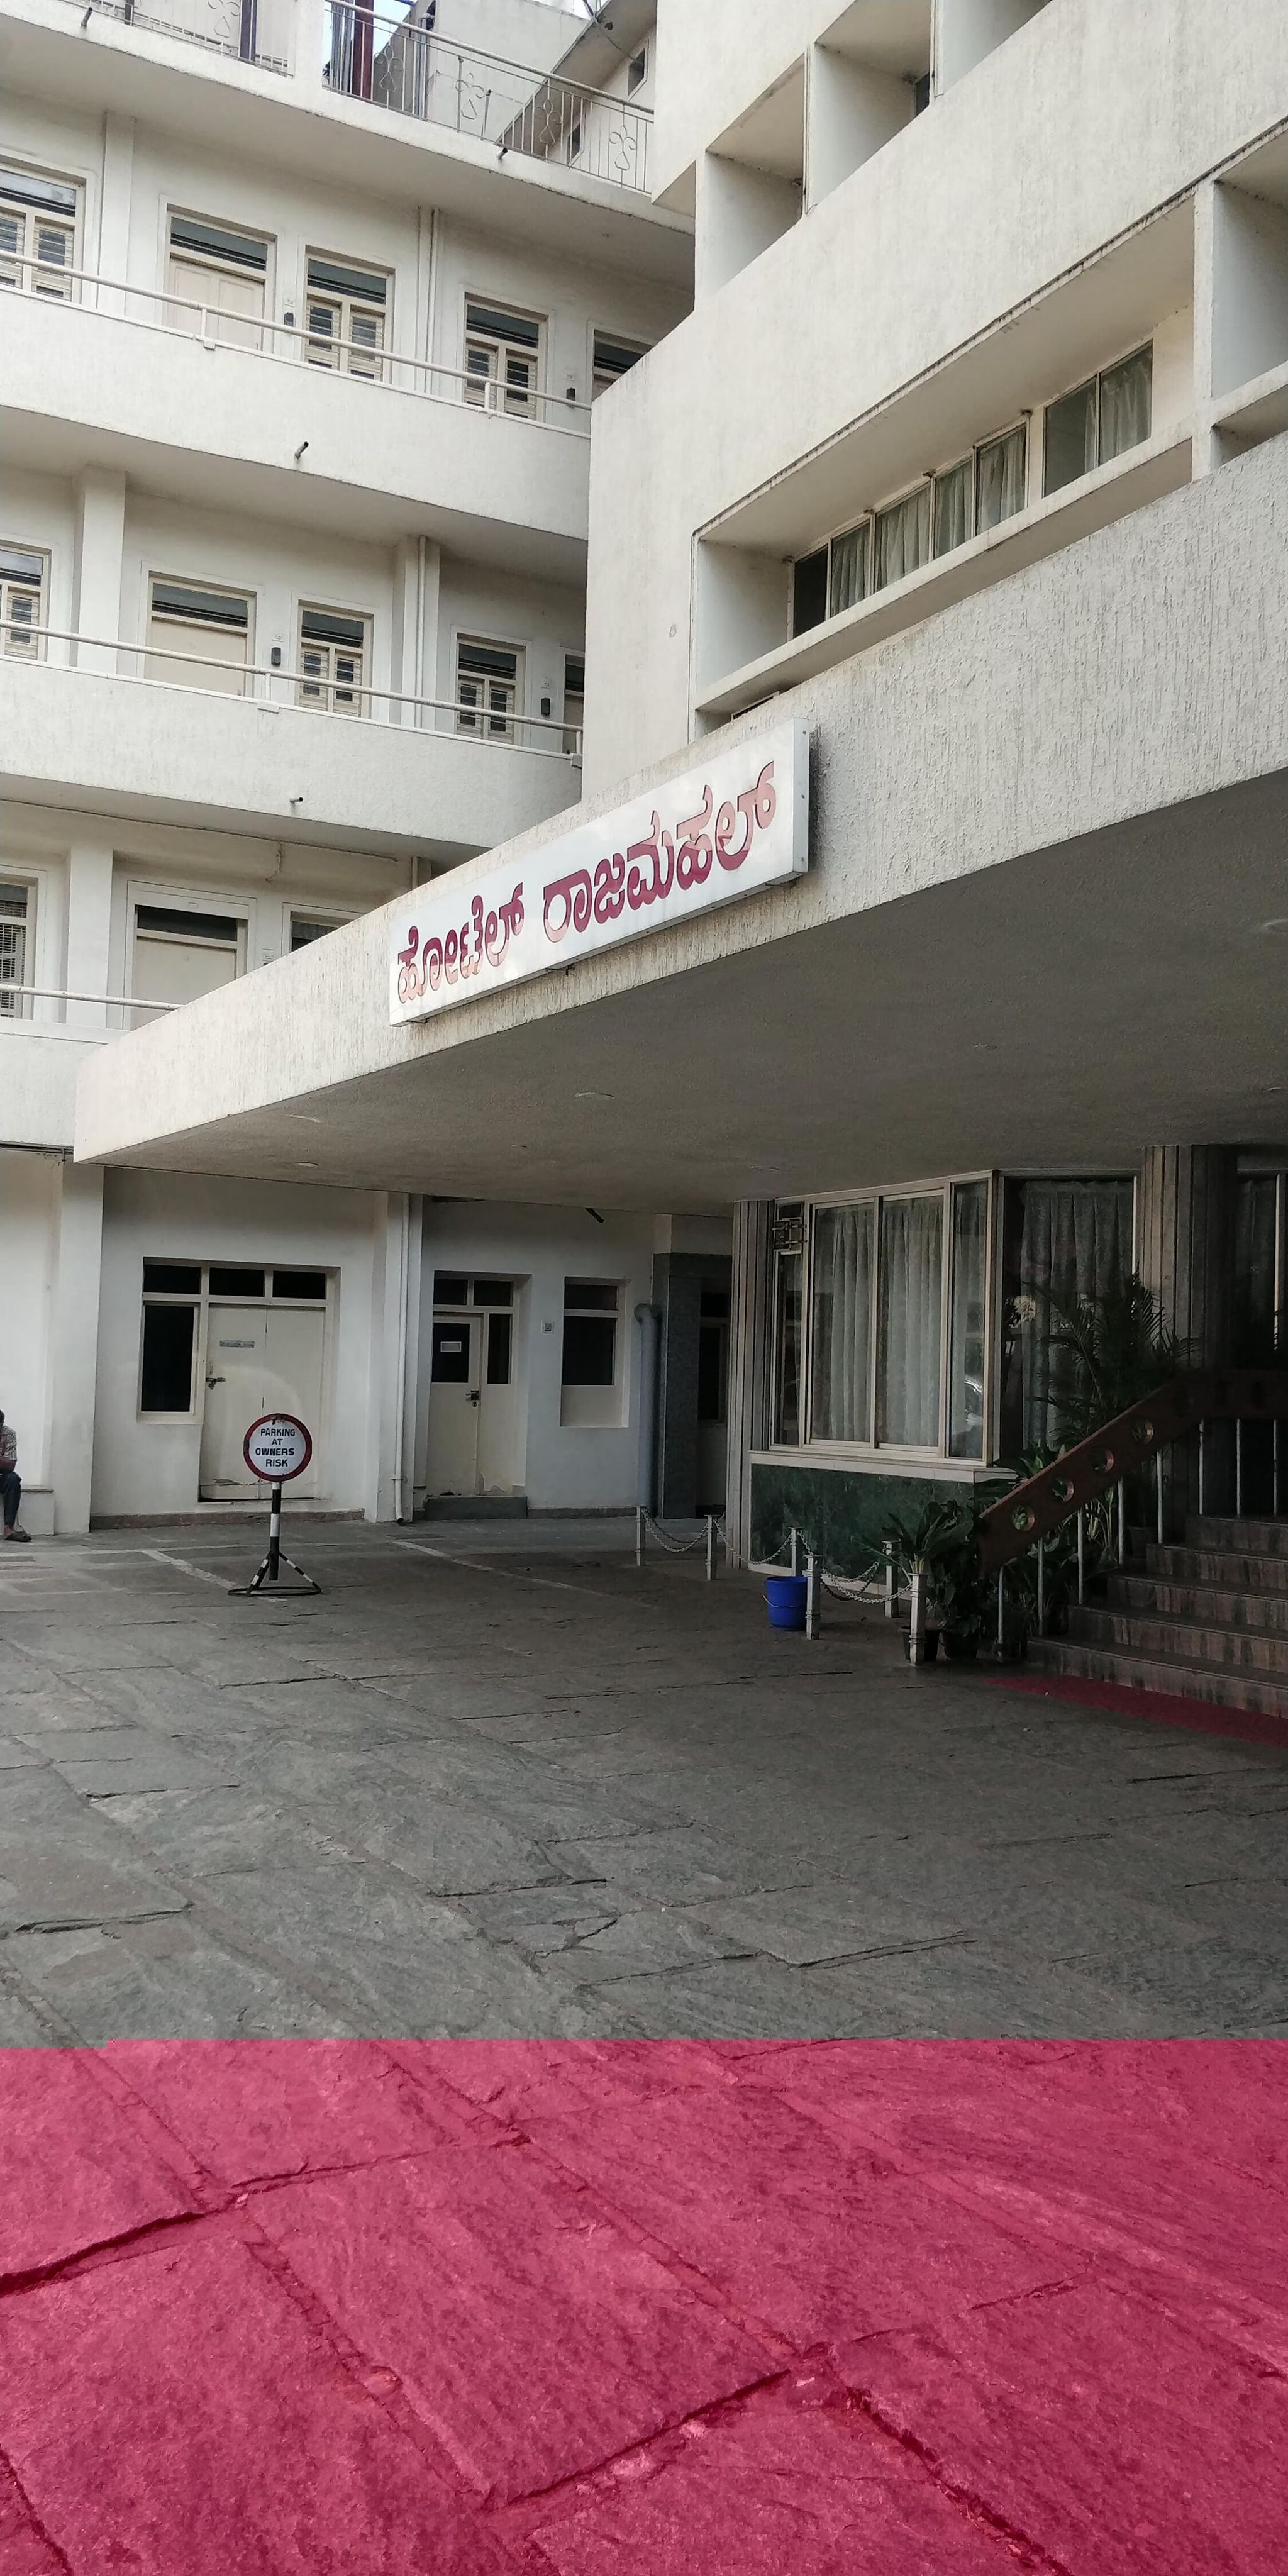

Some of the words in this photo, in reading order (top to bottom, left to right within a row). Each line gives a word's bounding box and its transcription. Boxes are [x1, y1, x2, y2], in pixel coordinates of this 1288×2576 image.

[398, 882, 524, 1003] ಹೋಟೆಲ್
[543, 761, 776, 943] ರಾಜಮಹಲ್
[260, 1428, 296, 1436] PARKING
[255, 1448, 294, 1456] OWNERS
[265, 1459, 288, 1467] RISK
